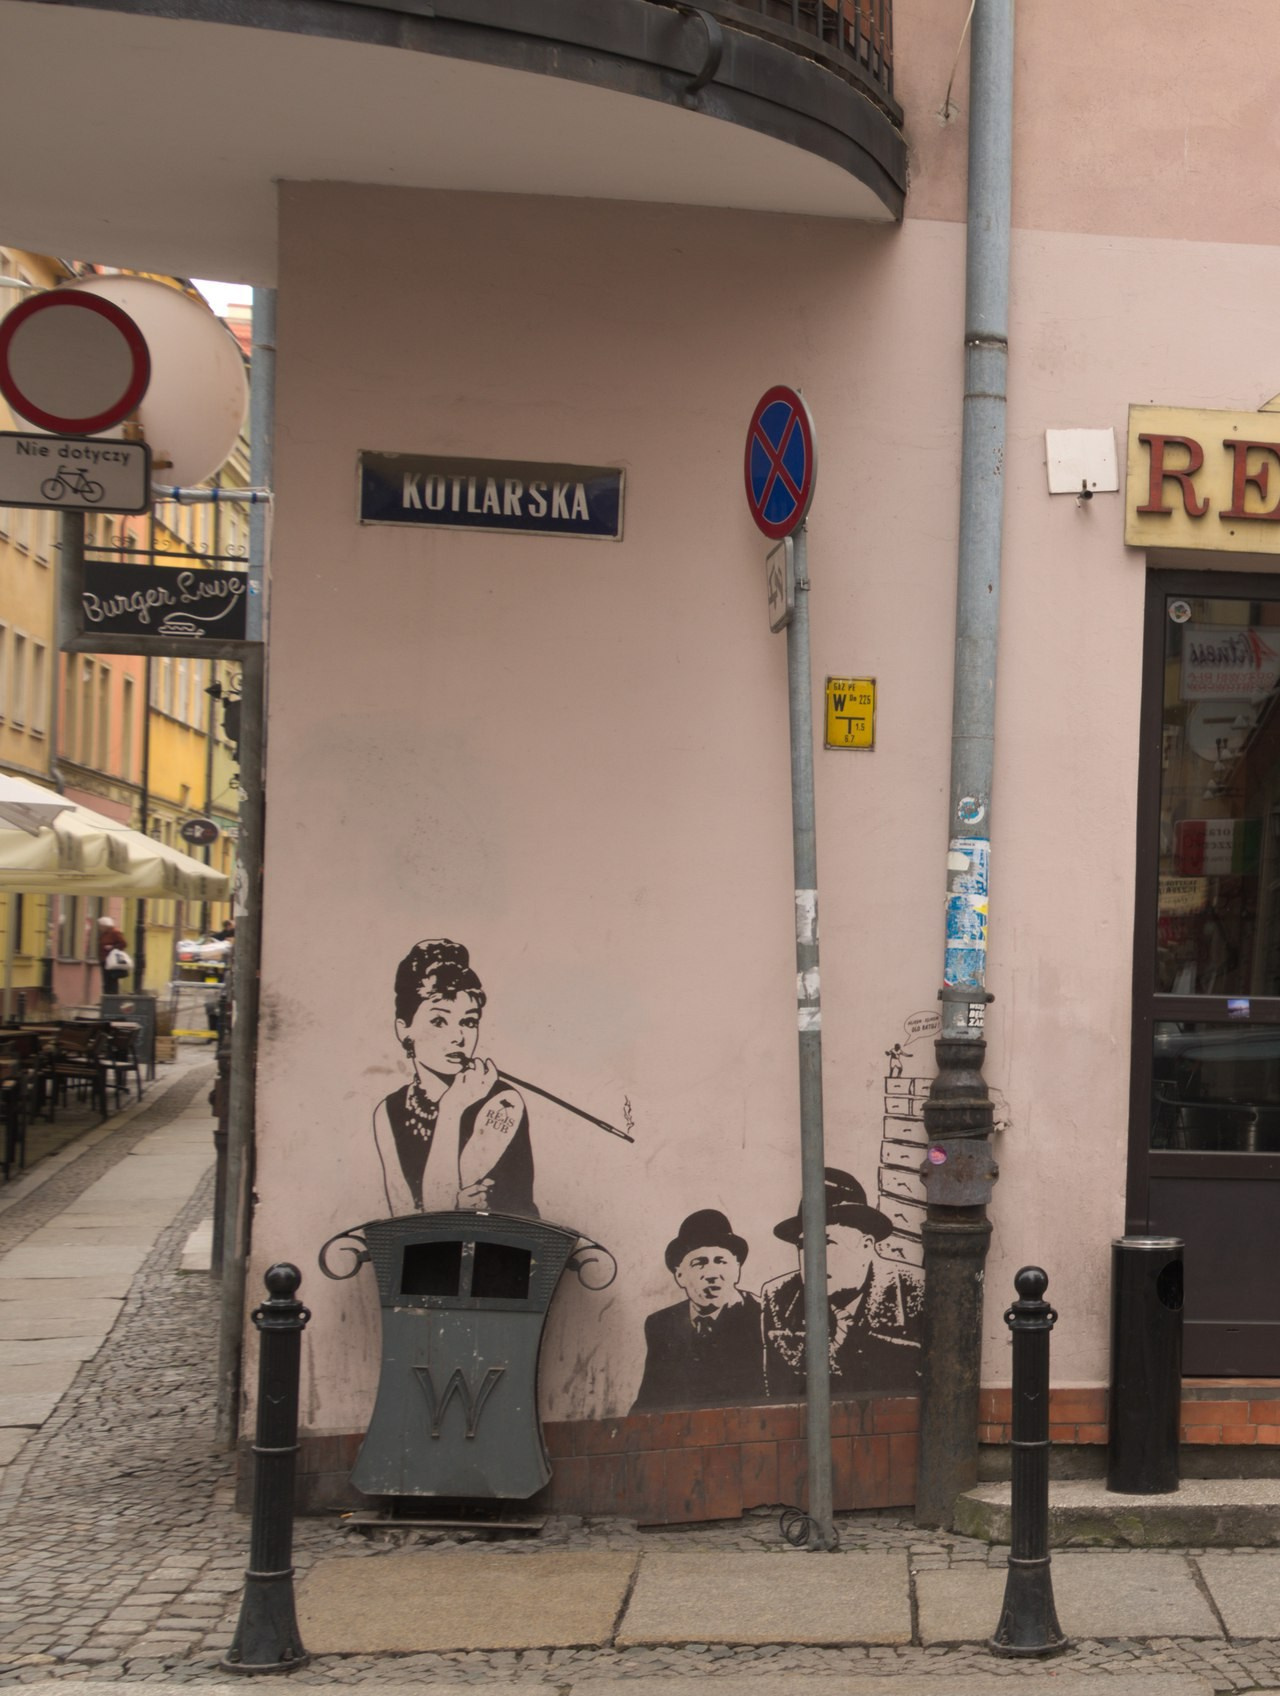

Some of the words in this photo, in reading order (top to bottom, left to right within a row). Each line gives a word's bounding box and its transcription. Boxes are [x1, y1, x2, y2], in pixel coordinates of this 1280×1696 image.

[17, 441, 49, 458] Nie
[58, 444, 131, 467] dotyczy
[402, 472, 590, 520] KOTLARSKA
[83, 586, 177, 624] Burger
[175, 571, 246, 602] Love
[833, 683, 845, 691] GAZ
[833, 694, 847, 712] W
[859, 694, 871, 705] 225
[485, 1118, 509, 1134] PUB
[486, 1109, 516, 1127] REJS
